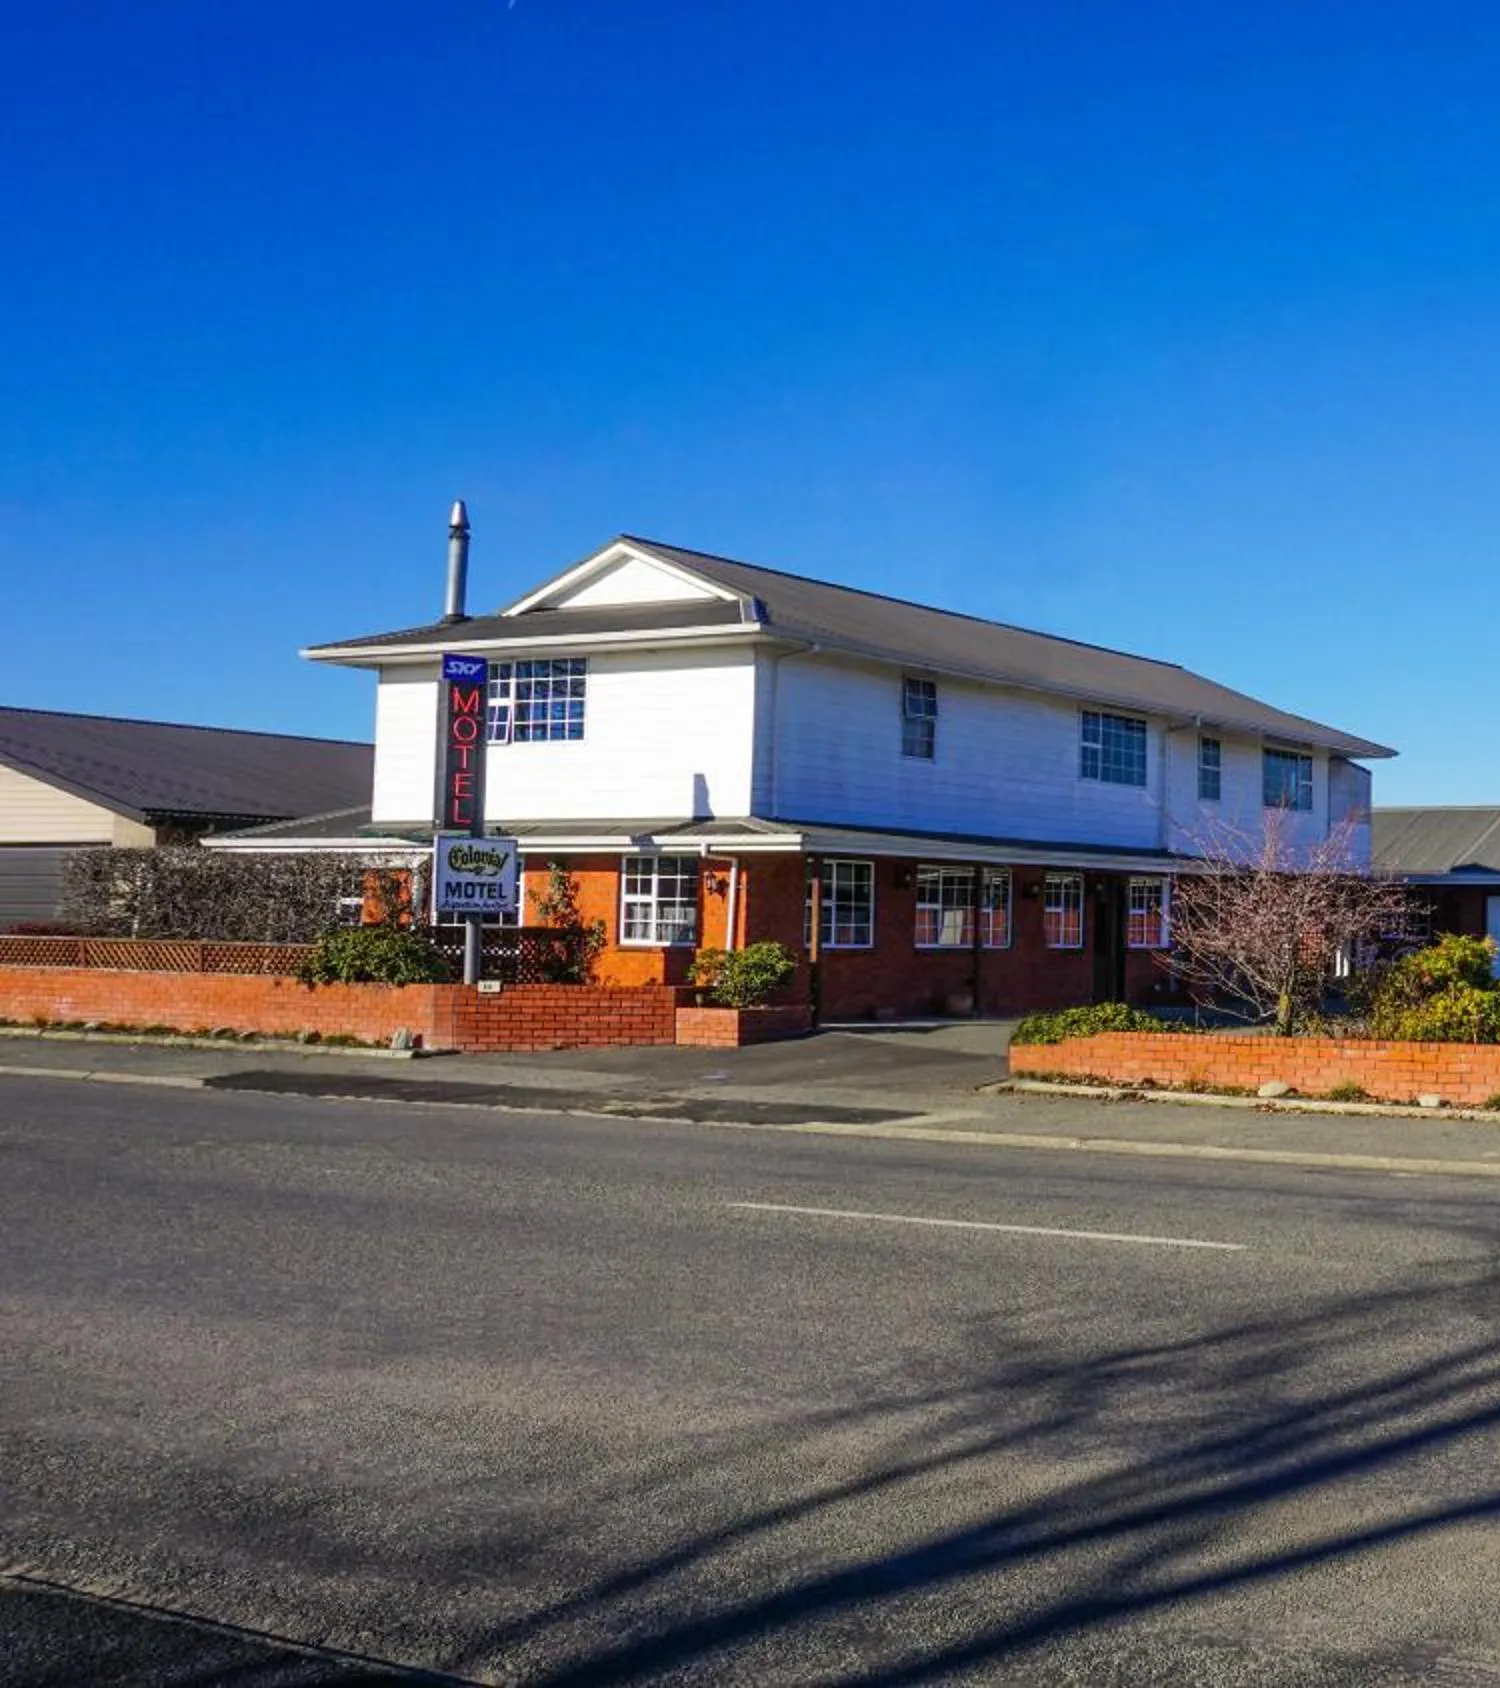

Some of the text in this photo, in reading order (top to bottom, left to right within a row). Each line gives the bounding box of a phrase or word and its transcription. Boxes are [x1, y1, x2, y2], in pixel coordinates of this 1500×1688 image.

[446, 661, 484, 675] SKY
[452, 686, 480, 824] MOTEL
[444, 881, 508, 899] MOTEL
